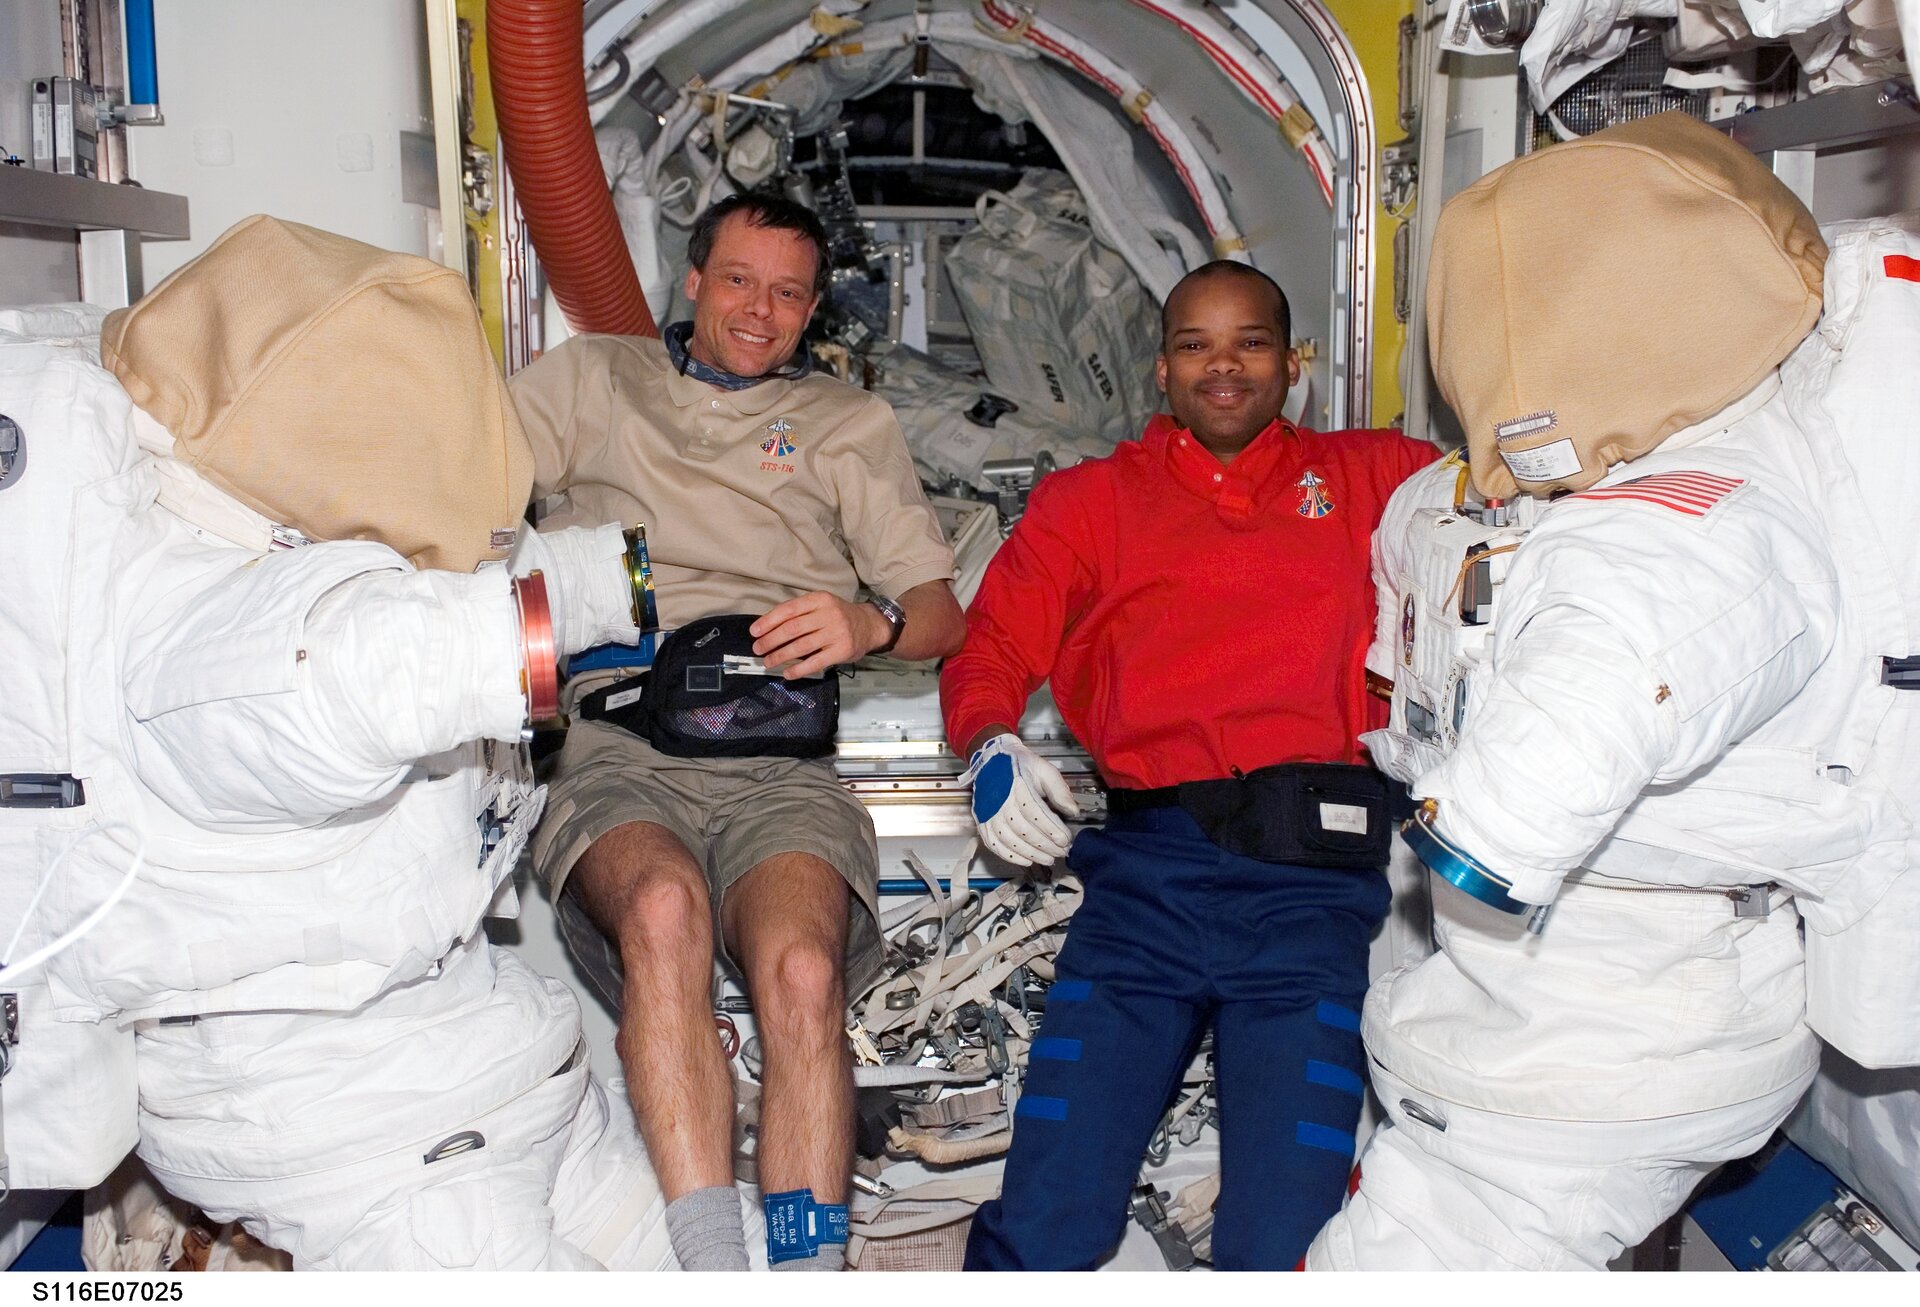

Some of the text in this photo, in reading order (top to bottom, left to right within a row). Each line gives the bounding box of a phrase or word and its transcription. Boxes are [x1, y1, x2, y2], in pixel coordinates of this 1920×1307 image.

[1041, 362, 1064, 403] SAFER
[1087, 353, 1113, 402] SAFER
[760, 461, 795, 473] STS-116
[771, 1213, 780, 1240] IVA-007
[787, 1204, 797, 1244] esa DLR
